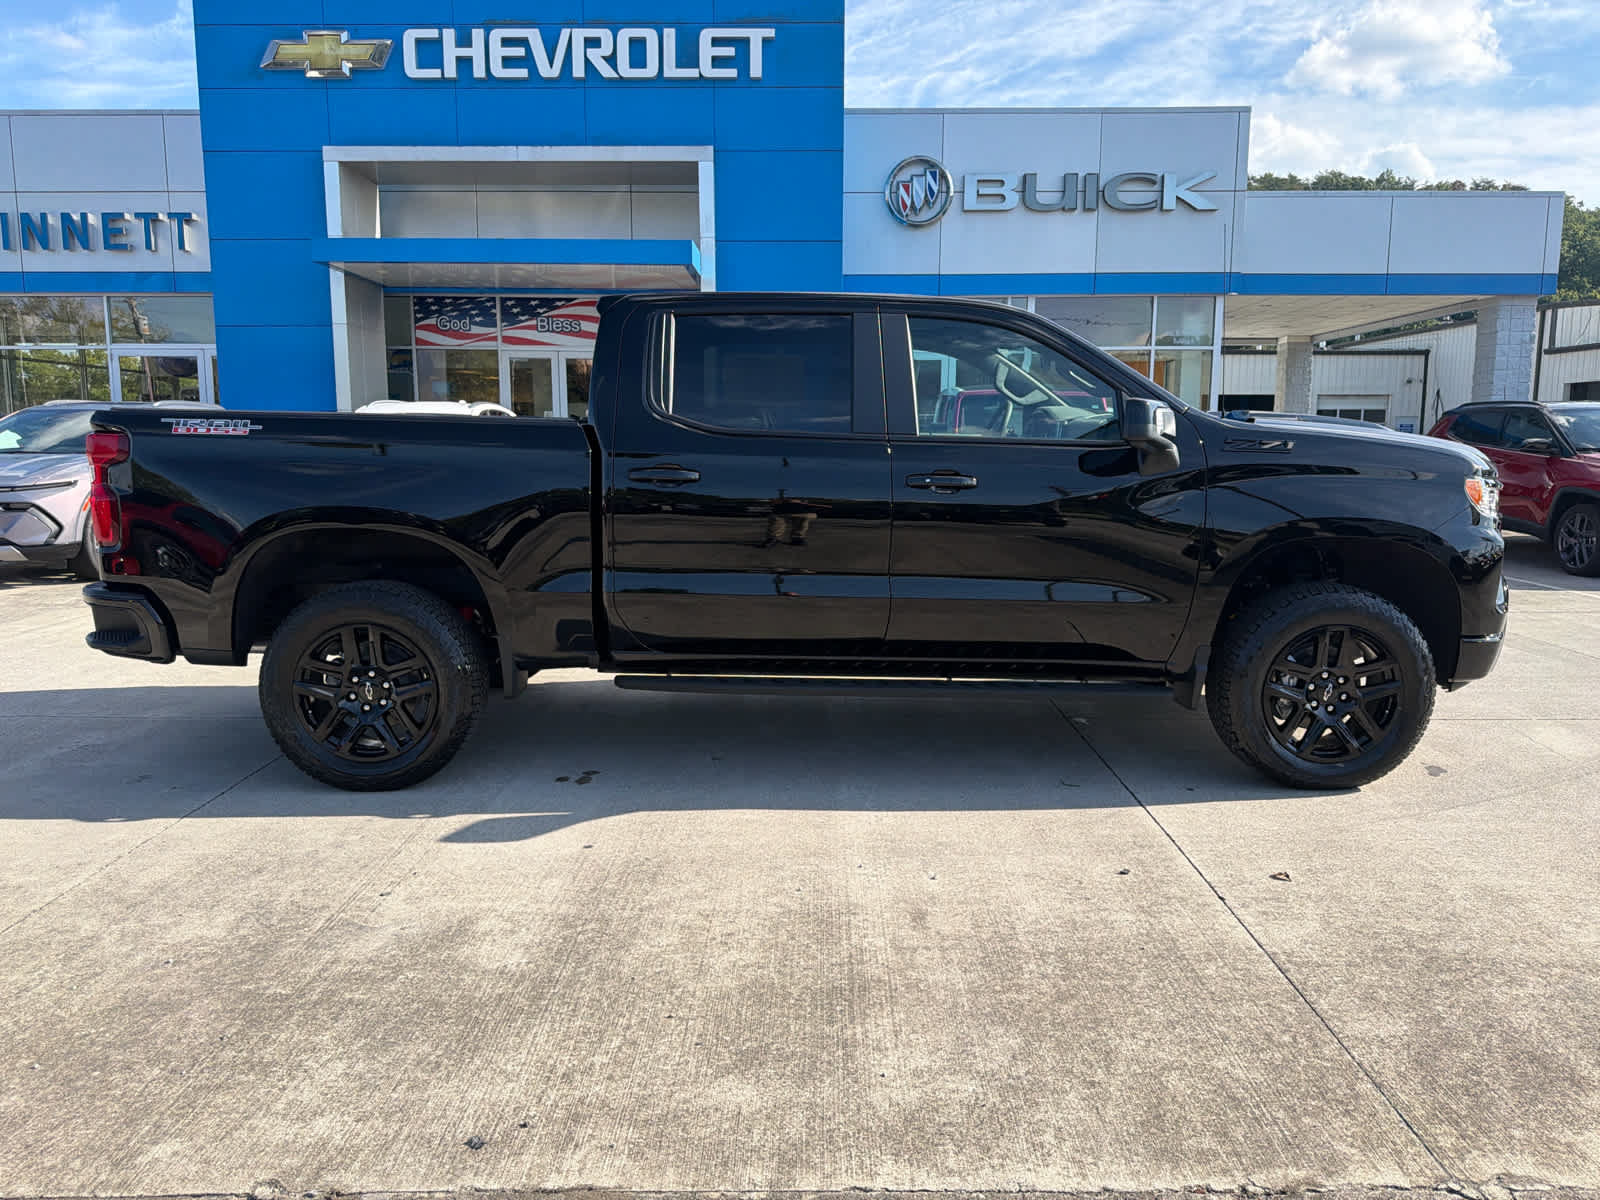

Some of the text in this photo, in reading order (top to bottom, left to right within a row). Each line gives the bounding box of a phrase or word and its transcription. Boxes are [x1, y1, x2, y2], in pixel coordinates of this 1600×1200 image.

[403, 27, 776, 80] CHEVROLET
[963, 171, 1218, 212] BUICK
[436, 315, 582, 332] God Bless
